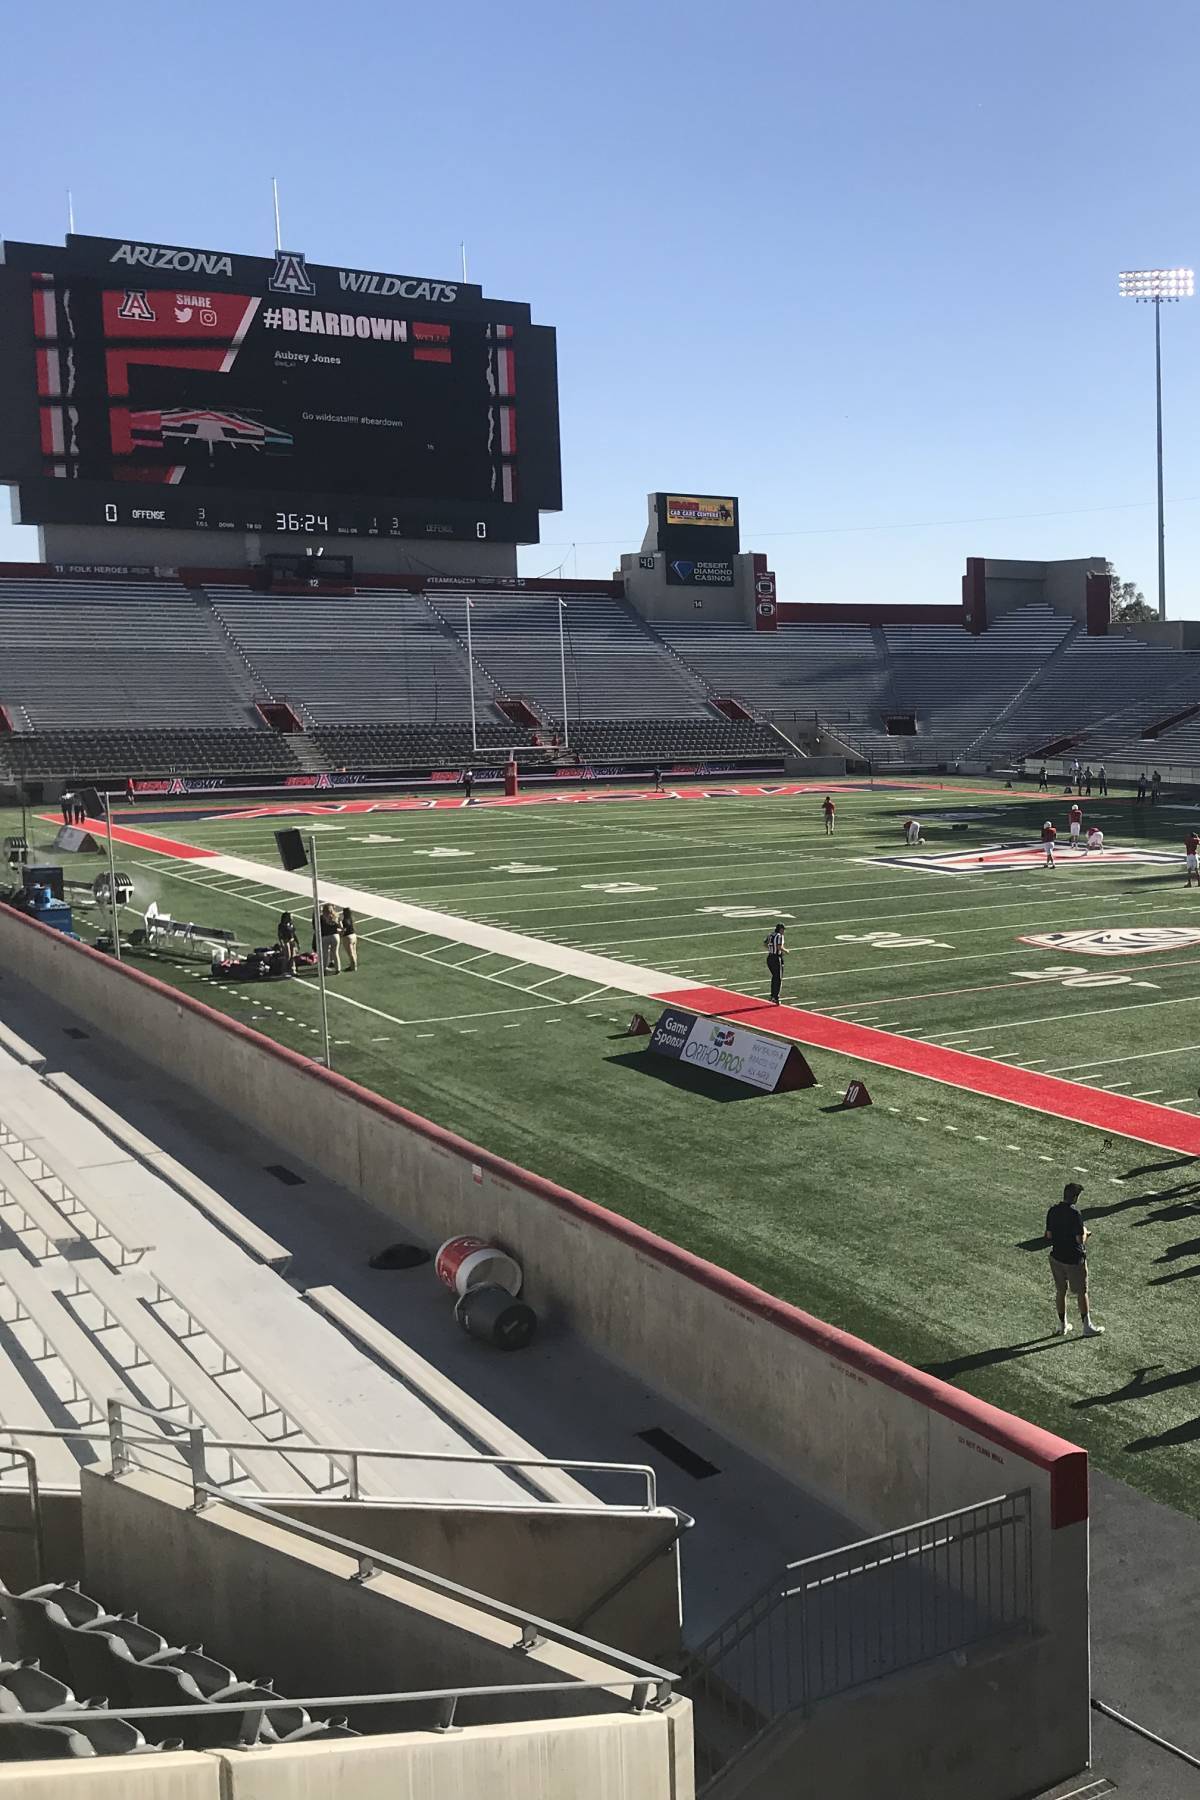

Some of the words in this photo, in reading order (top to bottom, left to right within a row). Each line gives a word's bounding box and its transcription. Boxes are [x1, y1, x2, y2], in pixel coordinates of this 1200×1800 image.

[109, 244, 233, 277] ARIZONA
[338, 271, 458, 303] WILDCATS
[176, 293, 212, 309] SHARE
[263, 307, 407, 342] #BEARDOWN
[274, 349, 310, 364] Aubrey
[311, 353, 341, 365] Jones
[302, 411, 314, 421] Go
[132, 509, 166, 521] OFFENSE
[276, 512, 329, 532] 36:24
[69, 565, 92, 573] FOLK
[94, 566, 128, 574] HEROES
[693, 568, 733, 576] DIAMOND
[694, 574, 732, 582] CASINOS
[665, 1017, 688, 1036] Game
[654, 1028, 686, 1050] Sponsor
[685, 1041, 745, 1074] ORTHOPROS
[846, 1085, 860, 1102] 10
